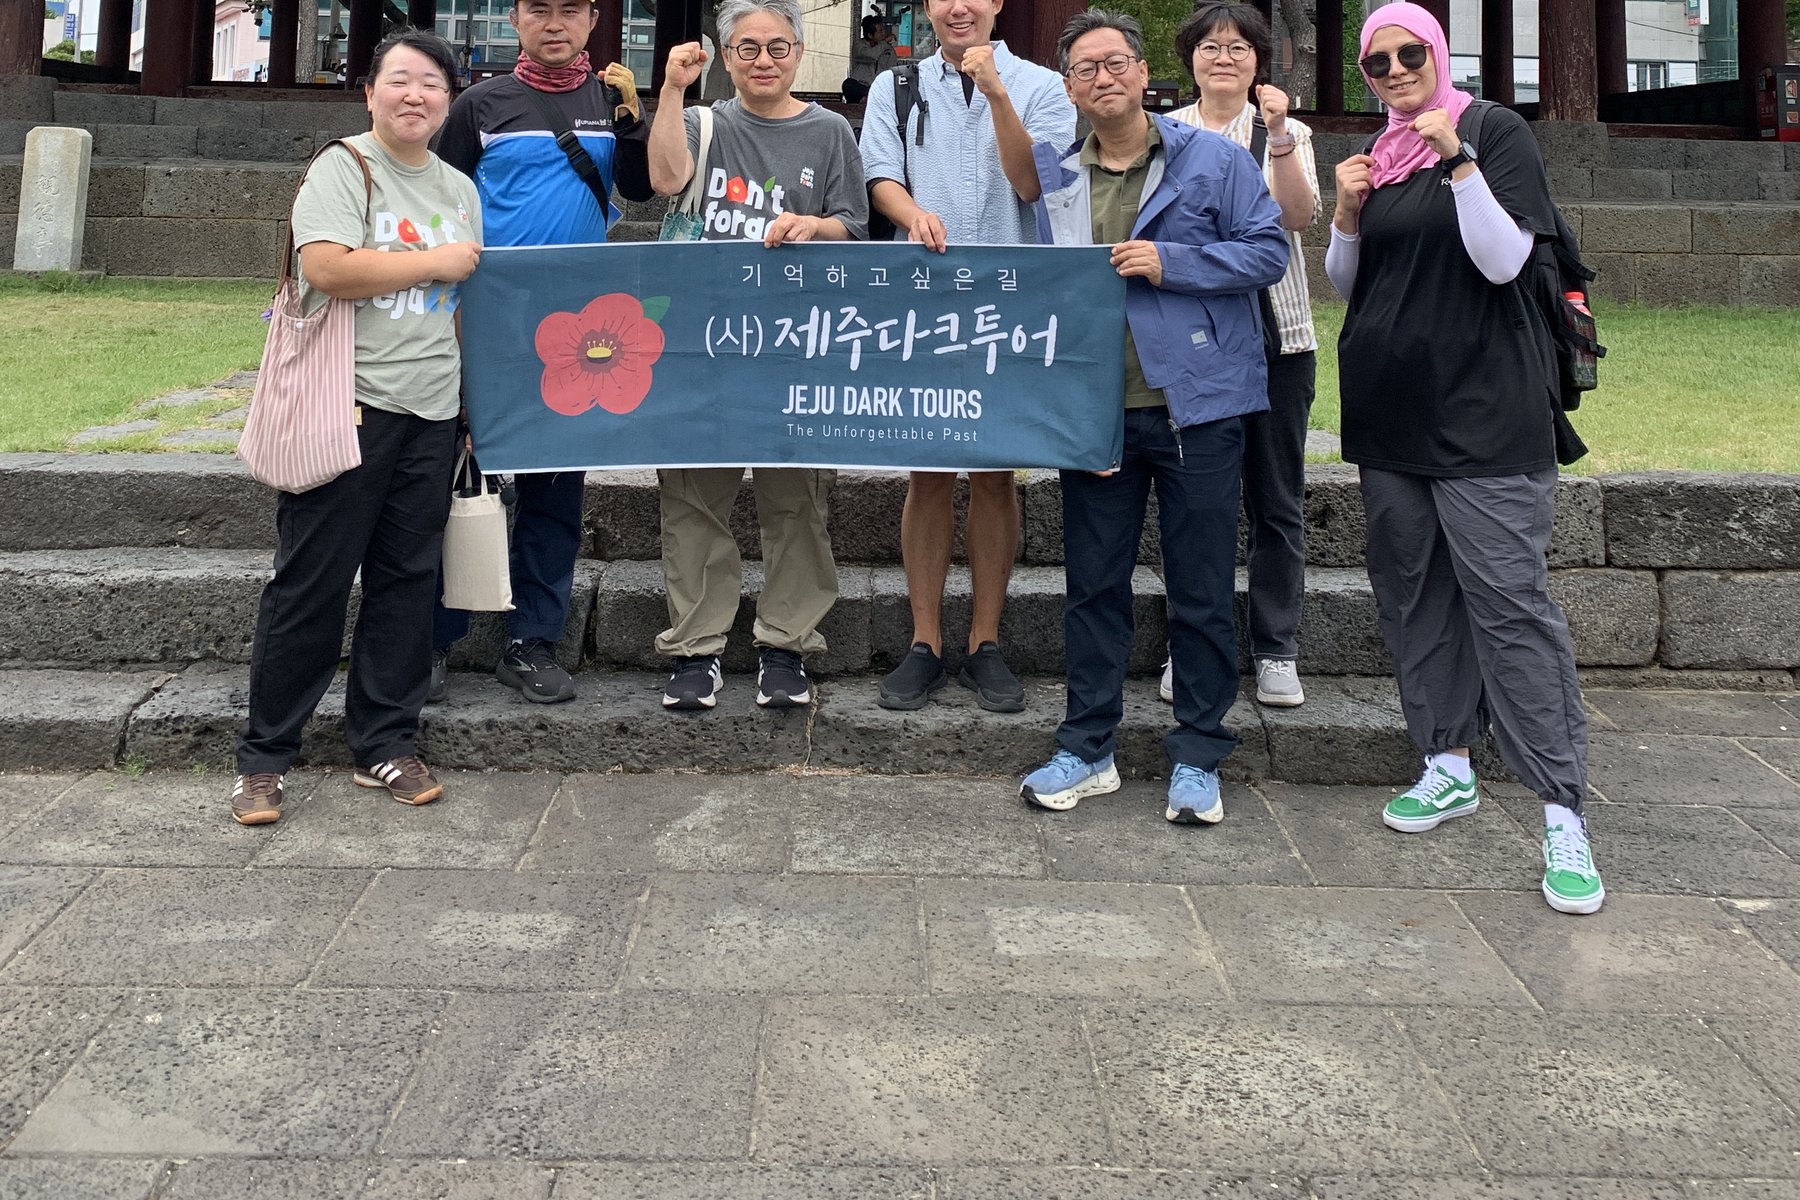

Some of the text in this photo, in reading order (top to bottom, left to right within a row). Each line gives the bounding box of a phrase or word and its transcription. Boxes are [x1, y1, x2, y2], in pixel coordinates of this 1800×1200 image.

[705, 304, 1058, 376] (사) 제주다크투어
[781, 385, 982, 420] JEJU DARK TOURS
[786, 423, 978, 442] The Unforgettable Past
